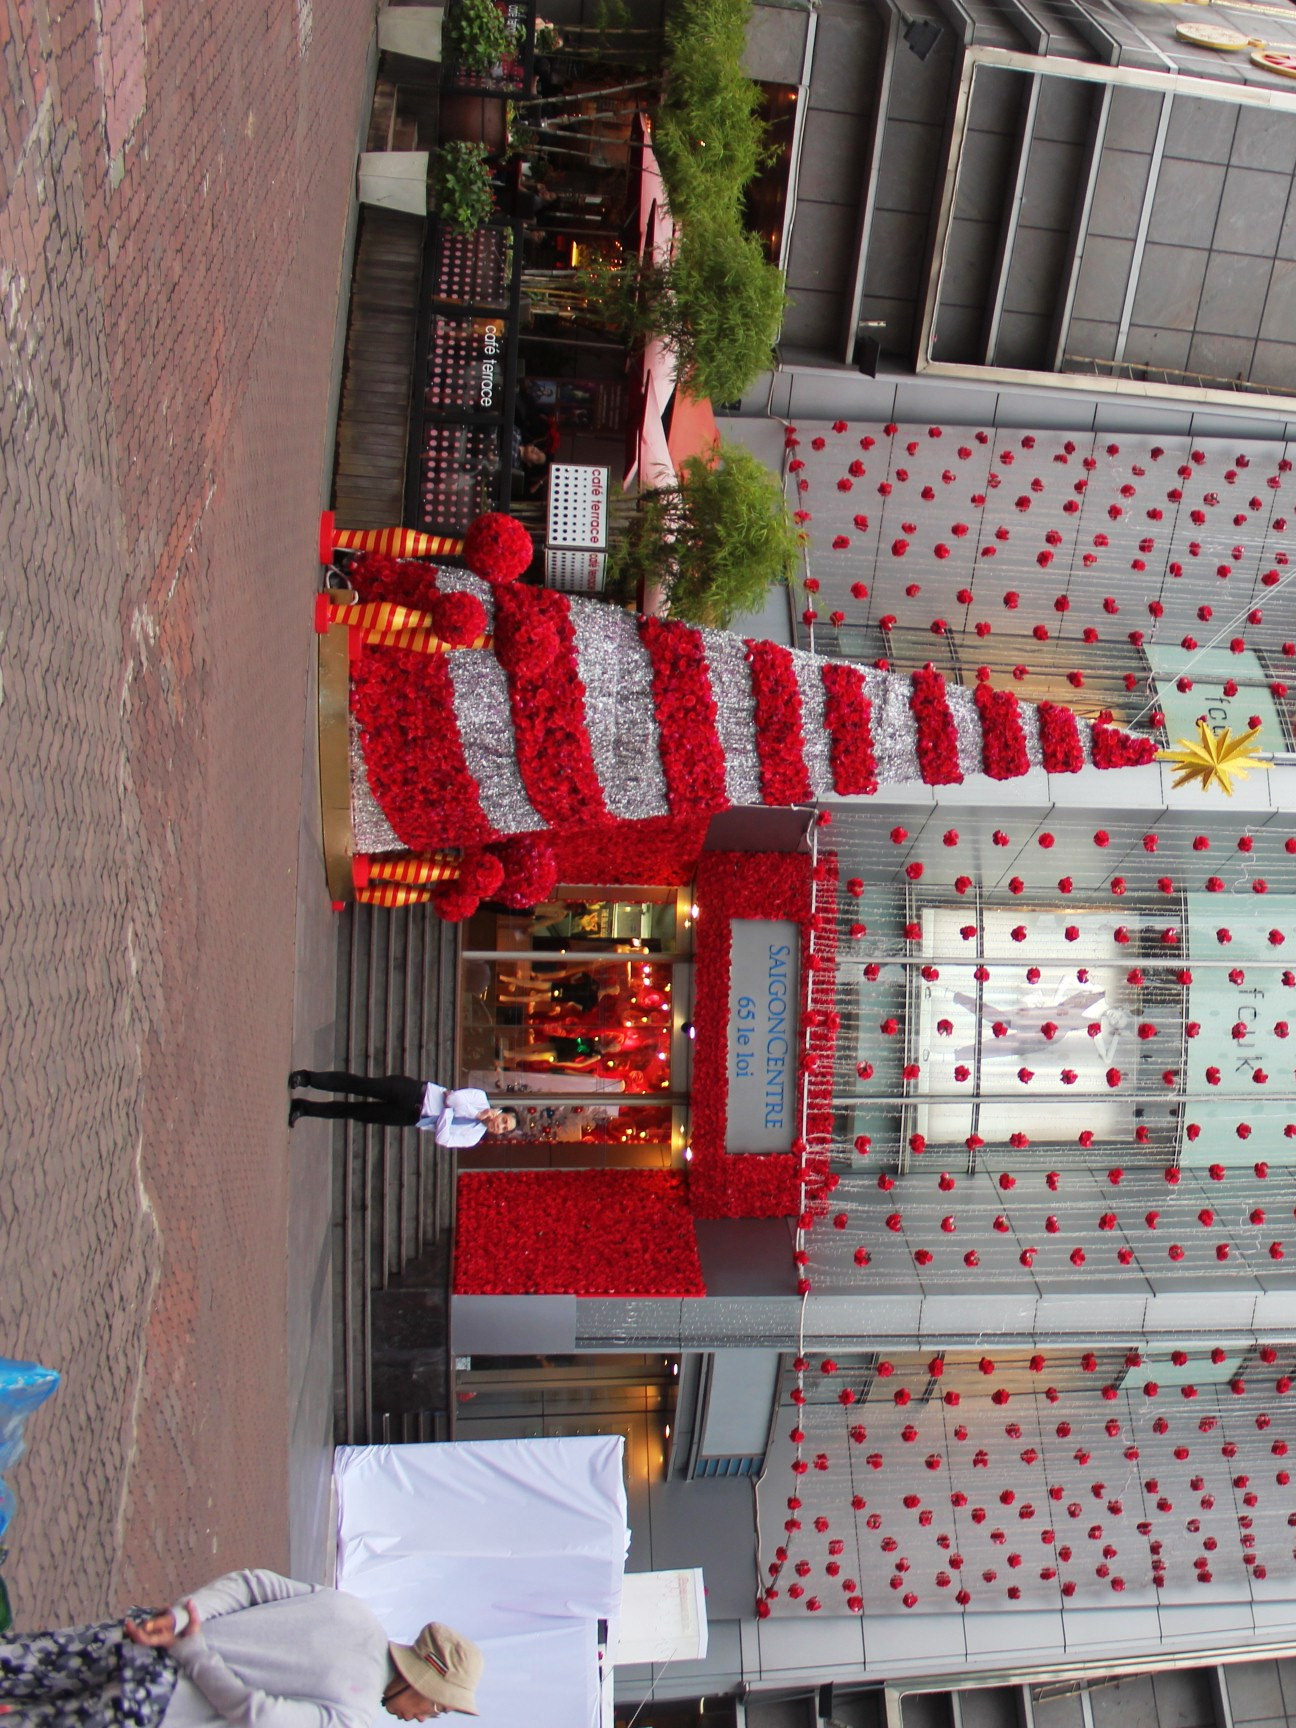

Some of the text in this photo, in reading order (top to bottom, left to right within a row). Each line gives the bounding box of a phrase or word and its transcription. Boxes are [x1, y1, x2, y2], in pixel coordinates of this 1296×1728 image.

[480, 325, 500, 407] café terrace
[590, 468, 603, 544] café terrace
[1204, 697, 1231, 737] fcu
[736, 996, 756, 1078] 65 le loi
[1235, 988, 1265, 1072] fcuk
